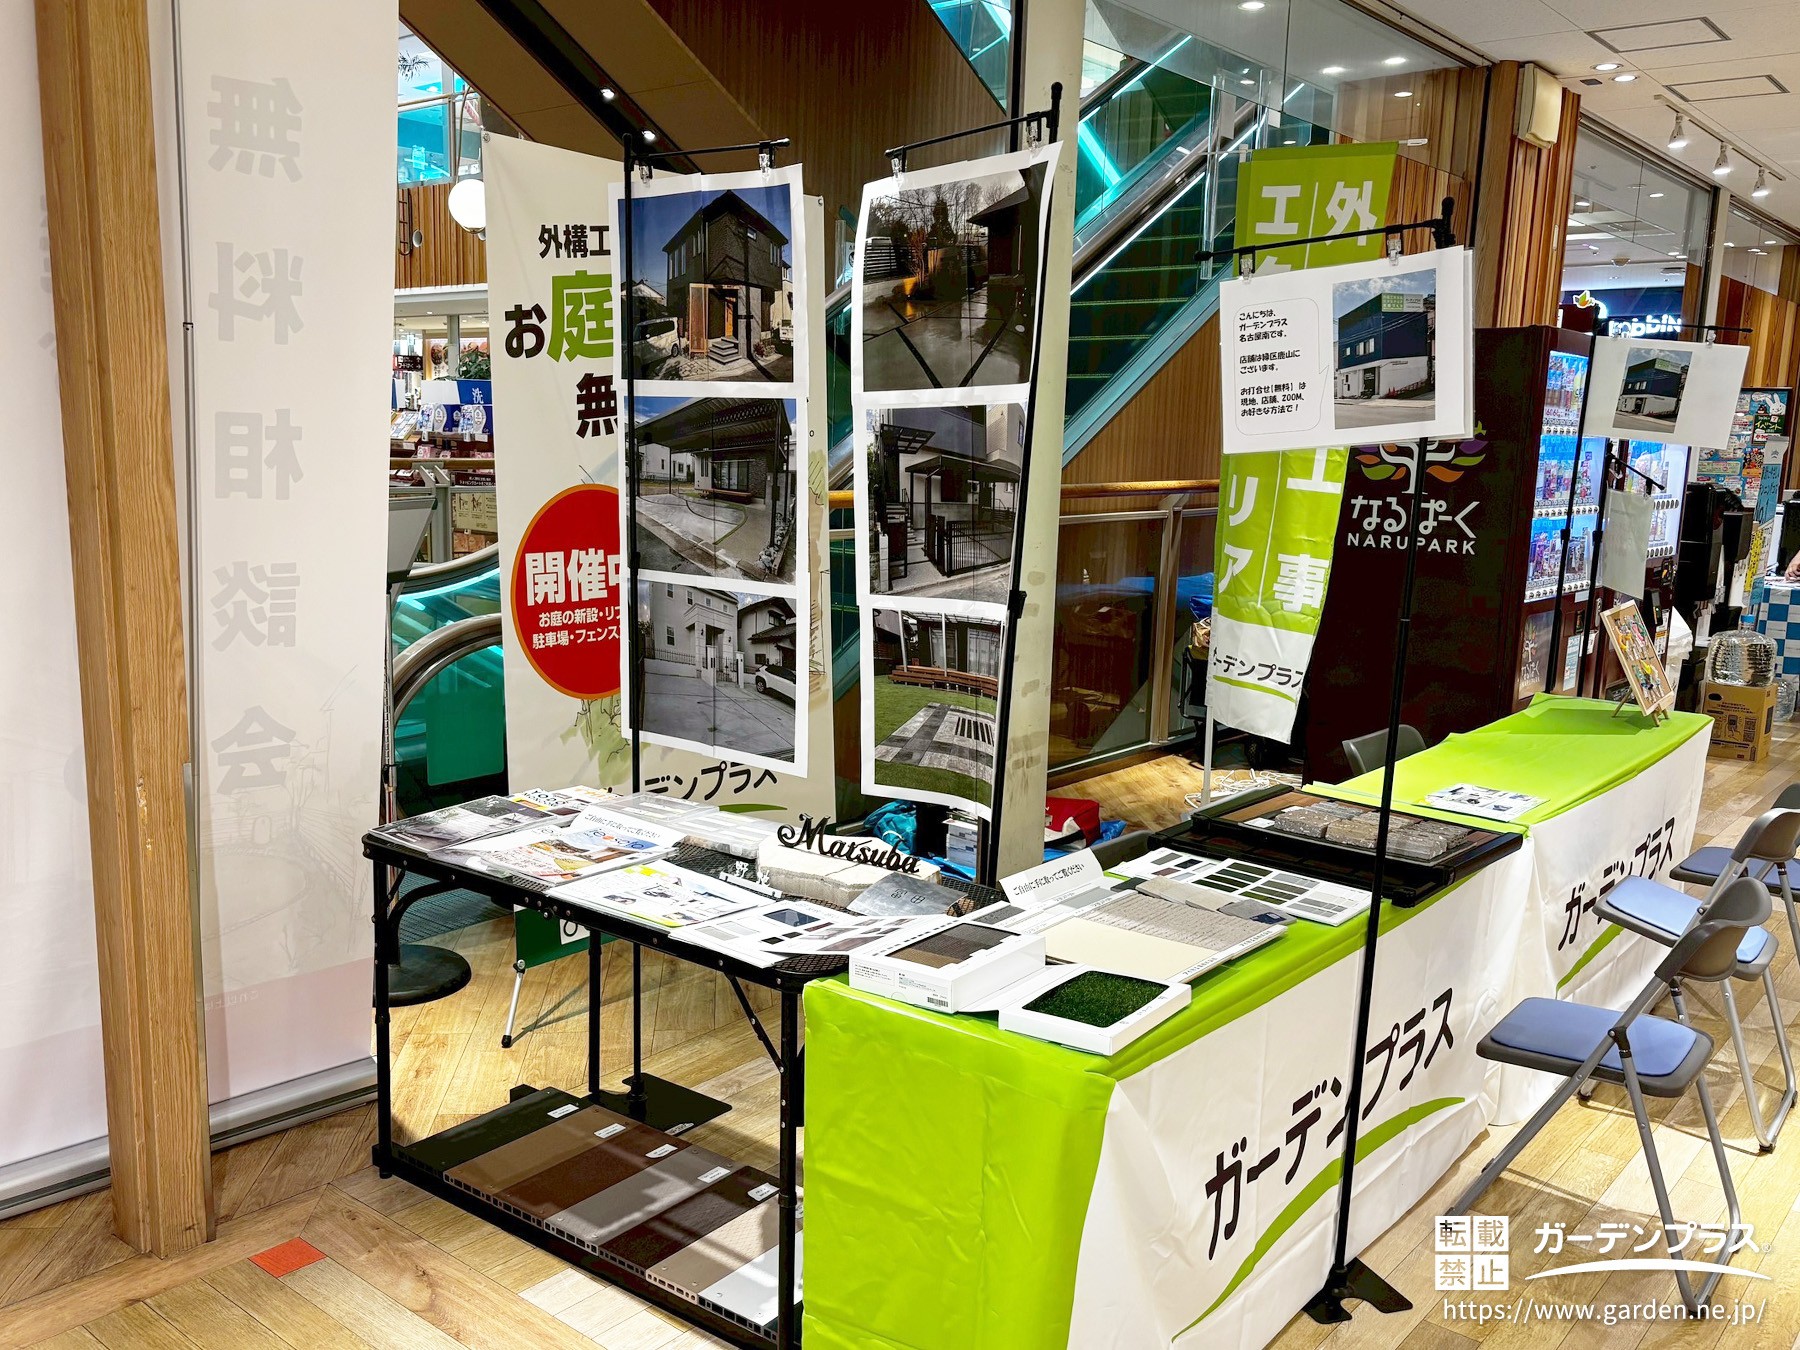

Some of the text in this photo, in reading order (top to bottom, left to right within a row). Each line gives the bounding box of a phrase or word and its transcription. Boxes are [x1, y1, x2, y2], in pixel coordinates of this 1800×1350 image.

[505, 270, 614, 363] お庭
[1239, 318, 1288, 331] ガーデンプラス
[1350, 495, 1480, 538] なるぱーく
[1347, 532, 1476, 555] NARUPARK
[532, 625, 621, 649] 駐車場・フェンス
[777, 813, 920, 874] Matsuba
[1205, 987, 1453, 1260] ガーデンプラス
